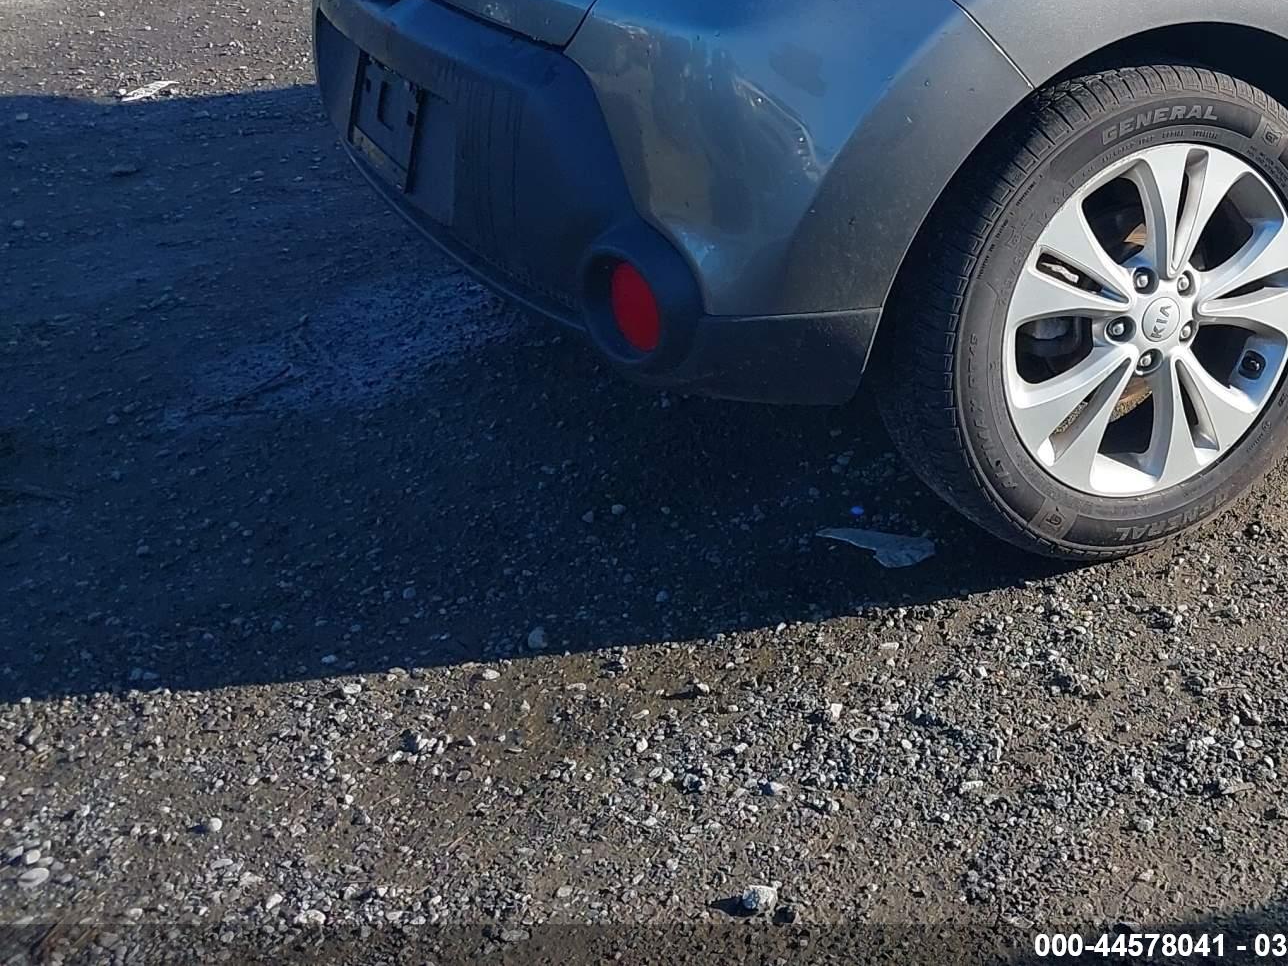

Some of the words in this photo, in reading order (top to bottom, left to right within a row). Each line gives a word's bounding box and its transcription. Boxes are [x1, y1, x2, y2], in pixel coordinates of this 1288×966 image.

[1102, 105, 1218, 146] GENERAL
[1264, 132, 1279, 144] GT
[1150, 305, 1172, 339] KIA
